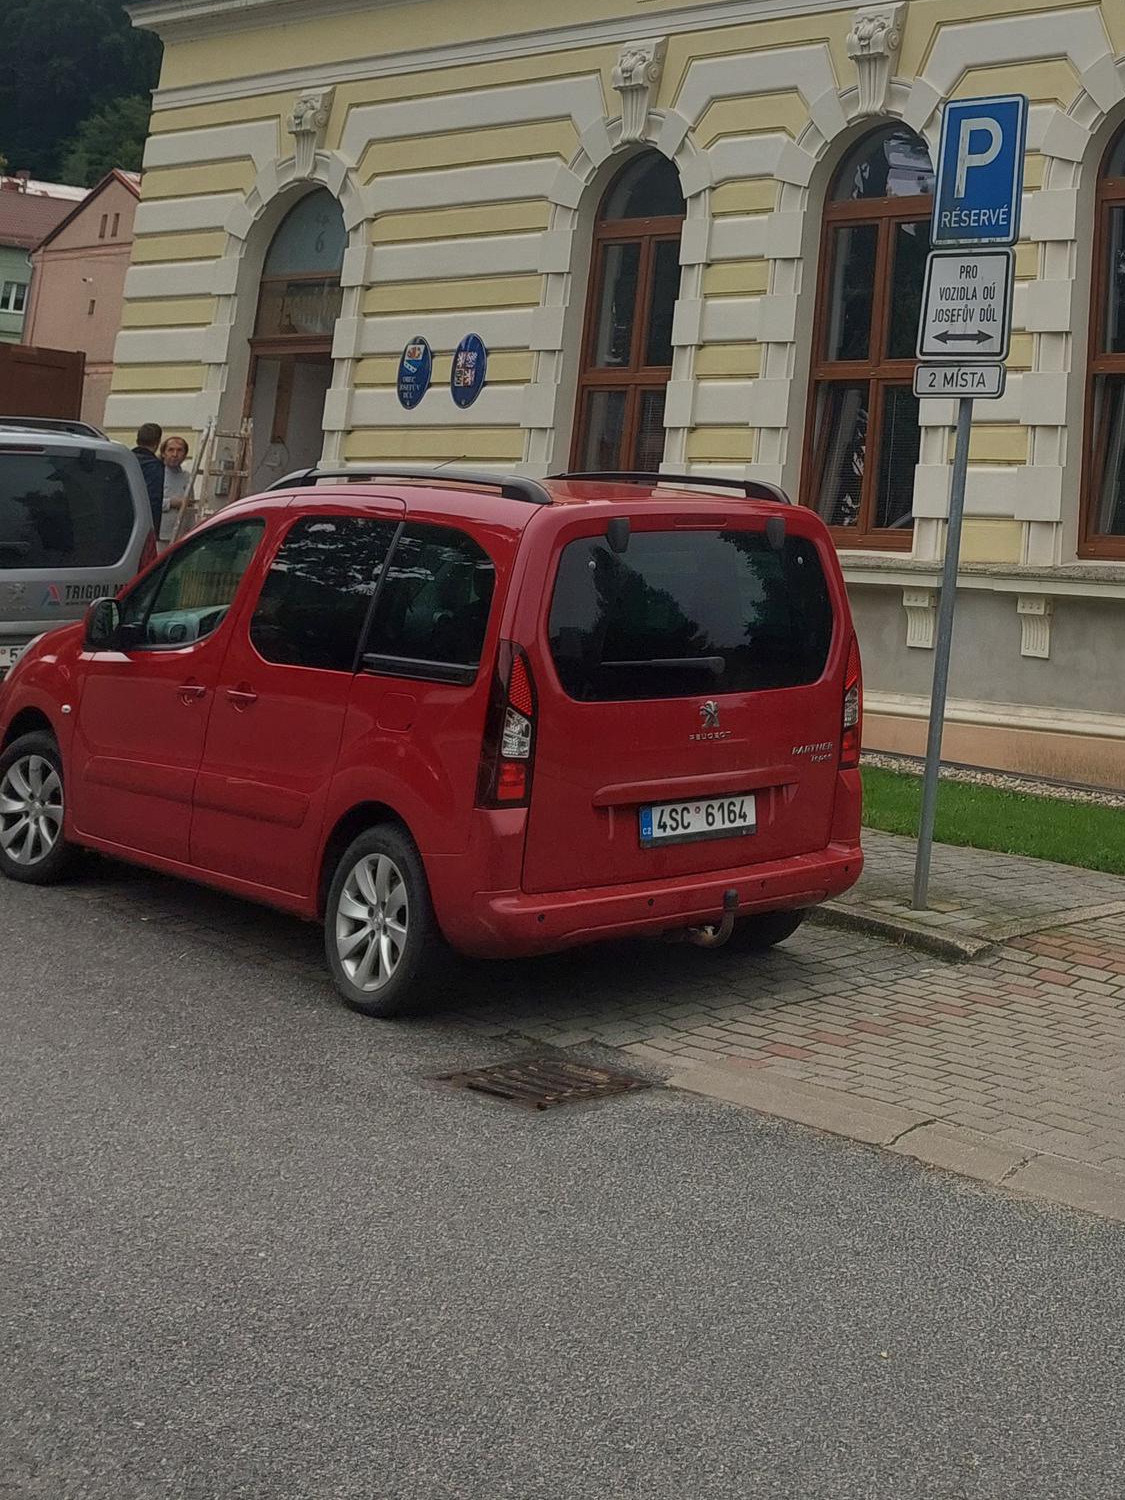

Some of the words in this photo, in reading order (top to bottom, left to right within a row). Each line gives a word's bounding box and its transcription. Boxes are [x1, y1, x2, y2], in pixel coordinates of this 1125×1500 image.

[953, 116, 1003, 199] P
[940, 204, 1009, 229] RÉSERVÉ
[959, 264, 978, 280] PRO
[939, 285, 978, 301] VOZIDLA
[982, 282, 996, 301] OÚ
[932, 303, 975, 323] JOSEFŮV
[979, 303, 997, 322] DŮL
[928, 371, 937, 388] 2
[942, 367, 986, 388] MÍSTA
[65, 584, 110, 600] TRIGON
[656, 806, 691, 833] 4SC
[705, 799, 748, 827] 6164
[642, 827, 652, 836] CZ
